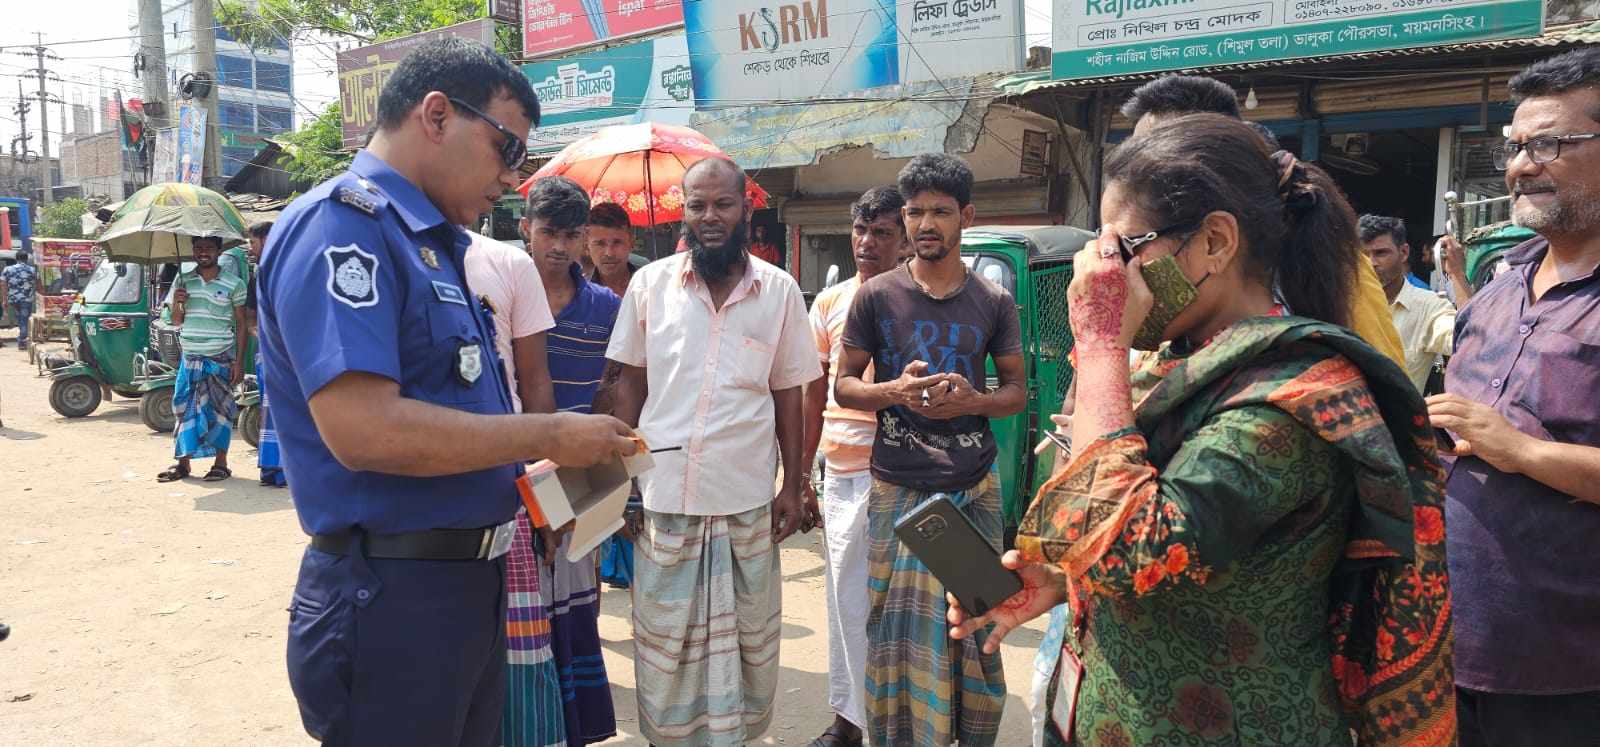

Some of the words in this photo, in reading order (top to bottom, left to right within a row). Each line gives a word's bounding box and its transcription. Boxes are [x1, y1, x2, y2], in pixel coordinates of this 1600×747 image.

[1086, 0, 1195, 18] Rajlax
[738, 0, 828, 53] KSRM
[1122, 22, 1168, 38] নিখিল
[1174, 18, 1201, 32] চন্দ্র
[1207, 10, 1262, 28] মোদক
[1116, 49, 1147, 64] নাজিম
[1151, 44, 1180, 61] উদ্দিন
[1183, 44, 1213, 58] রোড,
[1217, 36, 1254, 55] (শিমুল
[1258, 35, 1289, 50] তলা)
[1293, 30, 1333, 47] ভালুকা
[1338, 23, 1398, 42] পৌরসভা,
[774, 56, 797, 71] থেকে
[800, 50, 831, 67] শিখরে
[577, 70, 612, 97] সিমেন্ট
